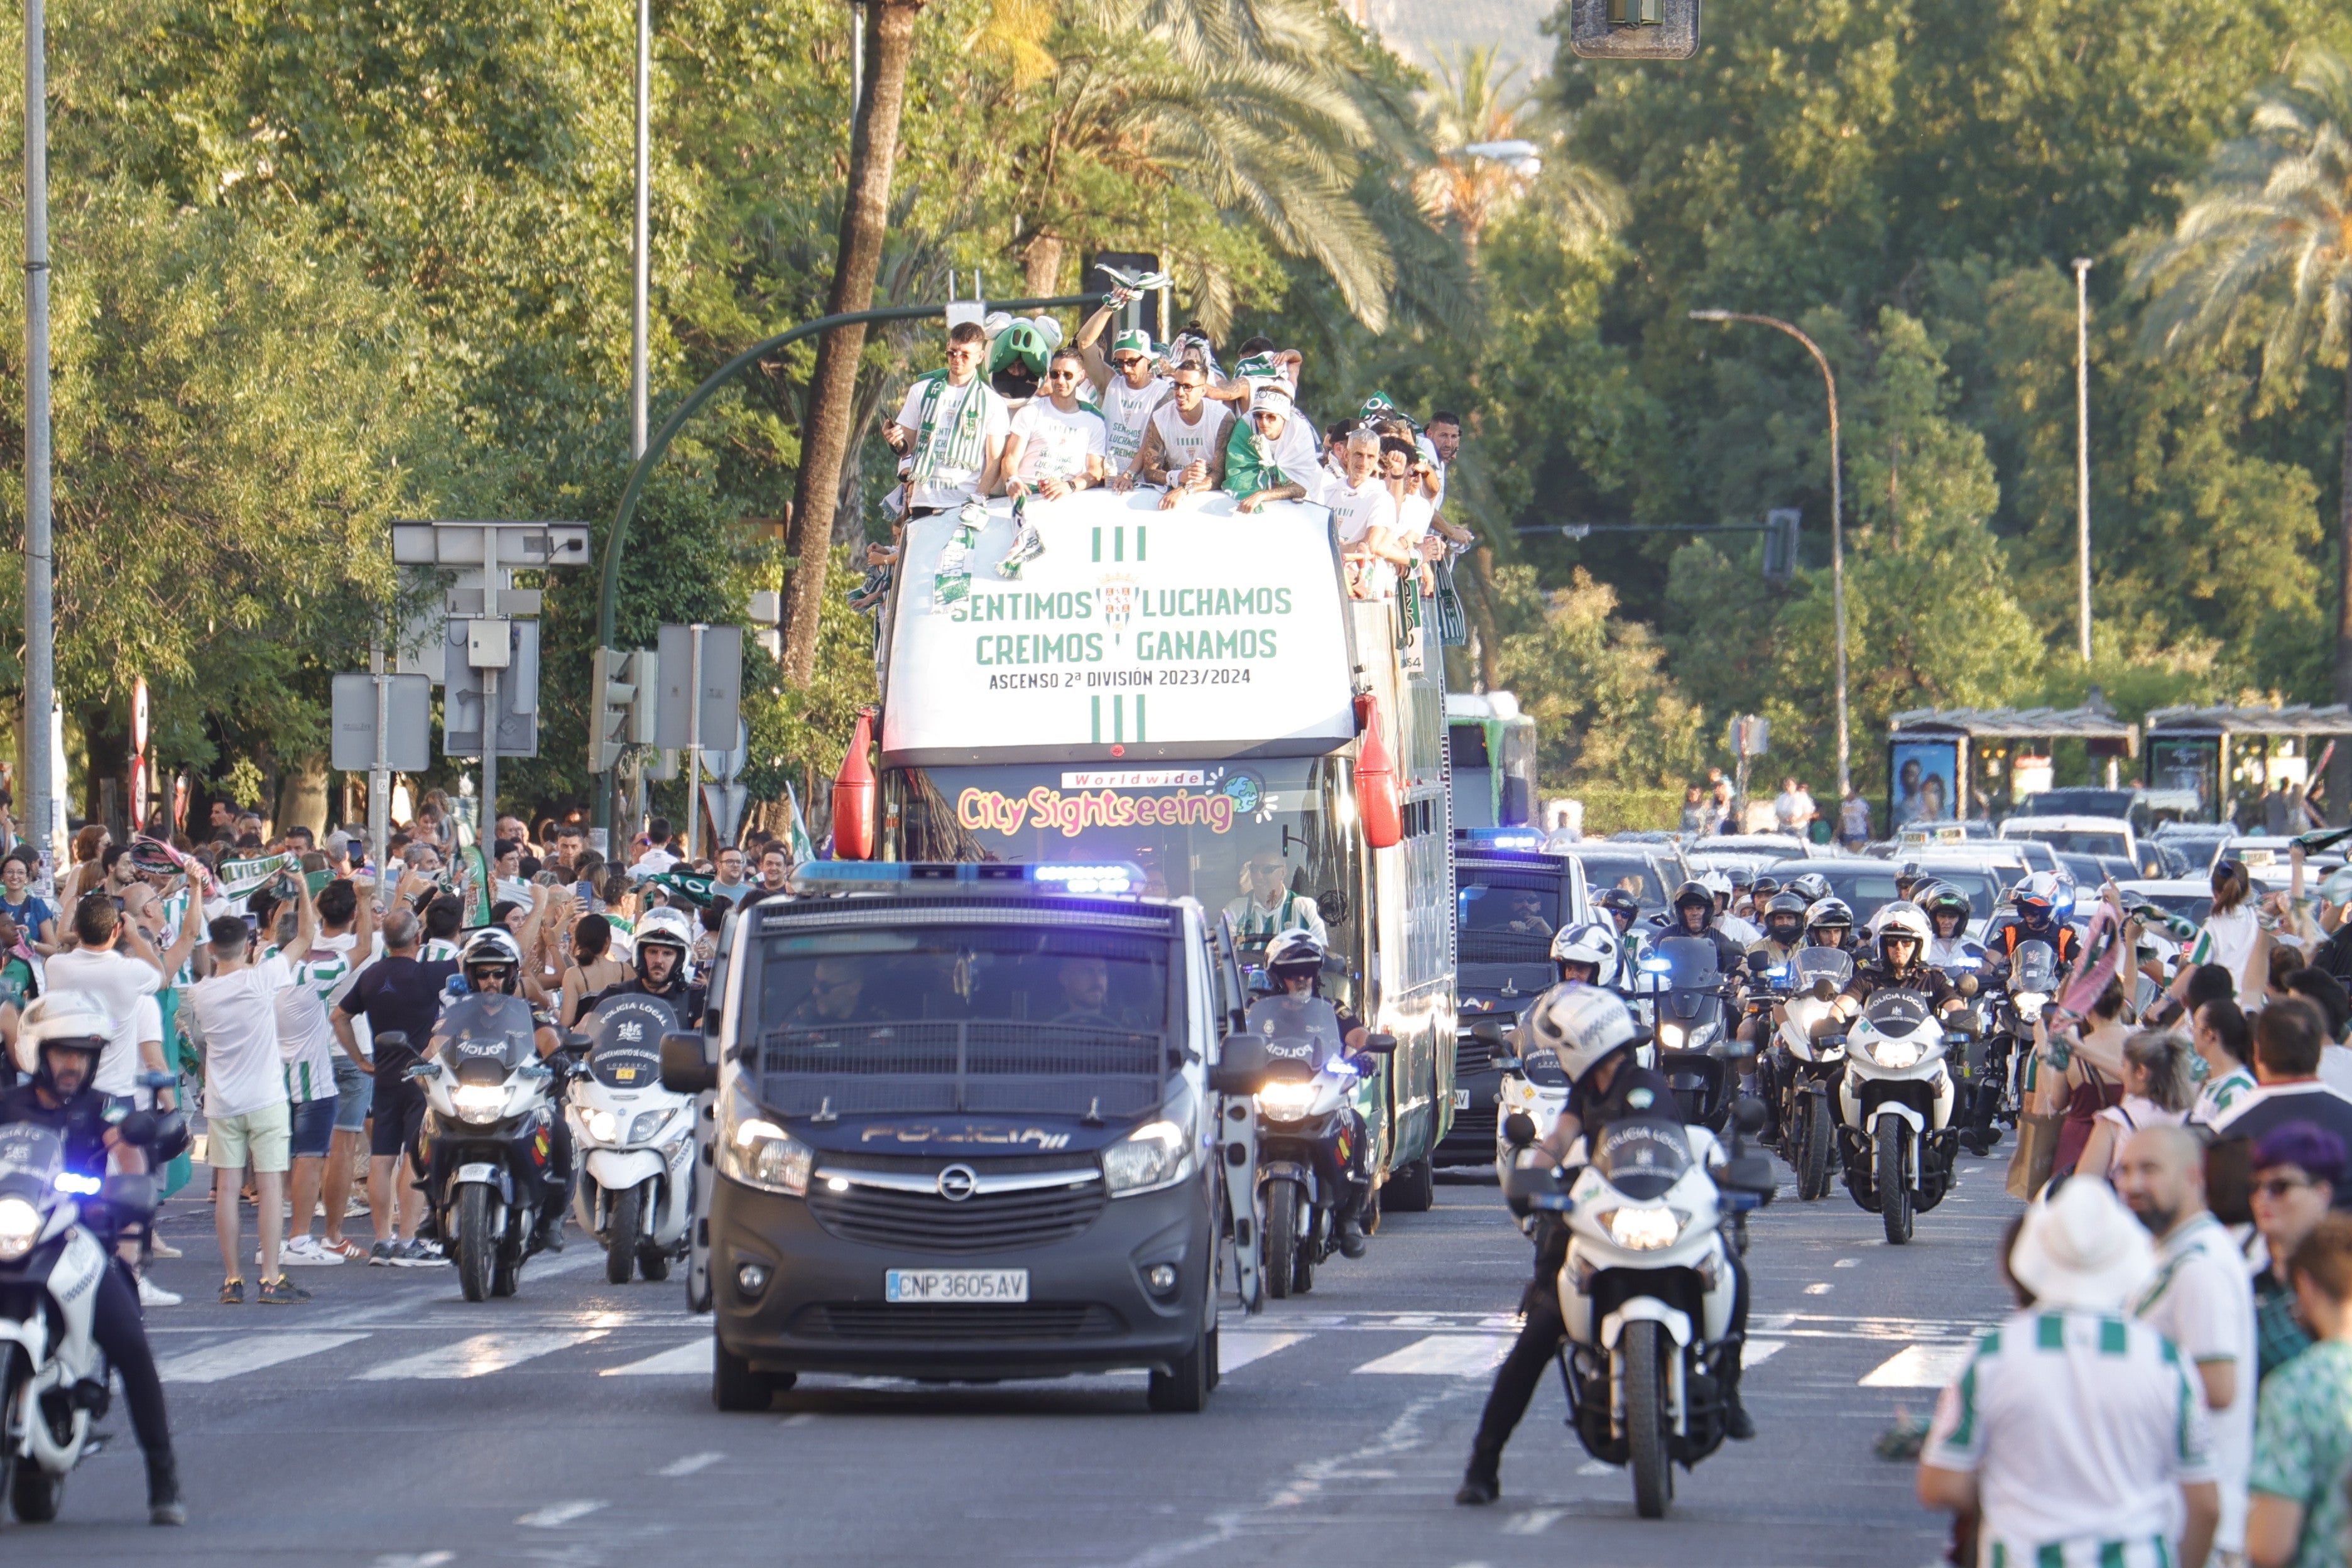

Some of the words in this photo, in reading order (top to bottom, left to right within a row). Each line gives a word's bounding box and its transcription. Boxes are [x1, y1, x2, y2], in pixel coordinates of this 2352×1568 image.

[1142, 587, 1292, 617] LUCHAMOS
[976, 633, 1103, 665] CREIMOS
[1136, 629, 1277, 661] GANAMOS
[989, 673, 1059, 690] ASCENSO
[1065, 672, 1081, 687] 2ª
[1087, 667, 1152, 687] DIVISIÓN
[1159, 669, 1250, 685] 2023/2024
[1075, 773, 1199, 785] Worldwide
[599, 1002, 636, 1025] POLICIA
[639, 1003, 669, 1027] LOCAL
[639, 1050, 662, 1064] CORDOB
[861, 1124, 1048, 1146] POLICIA
